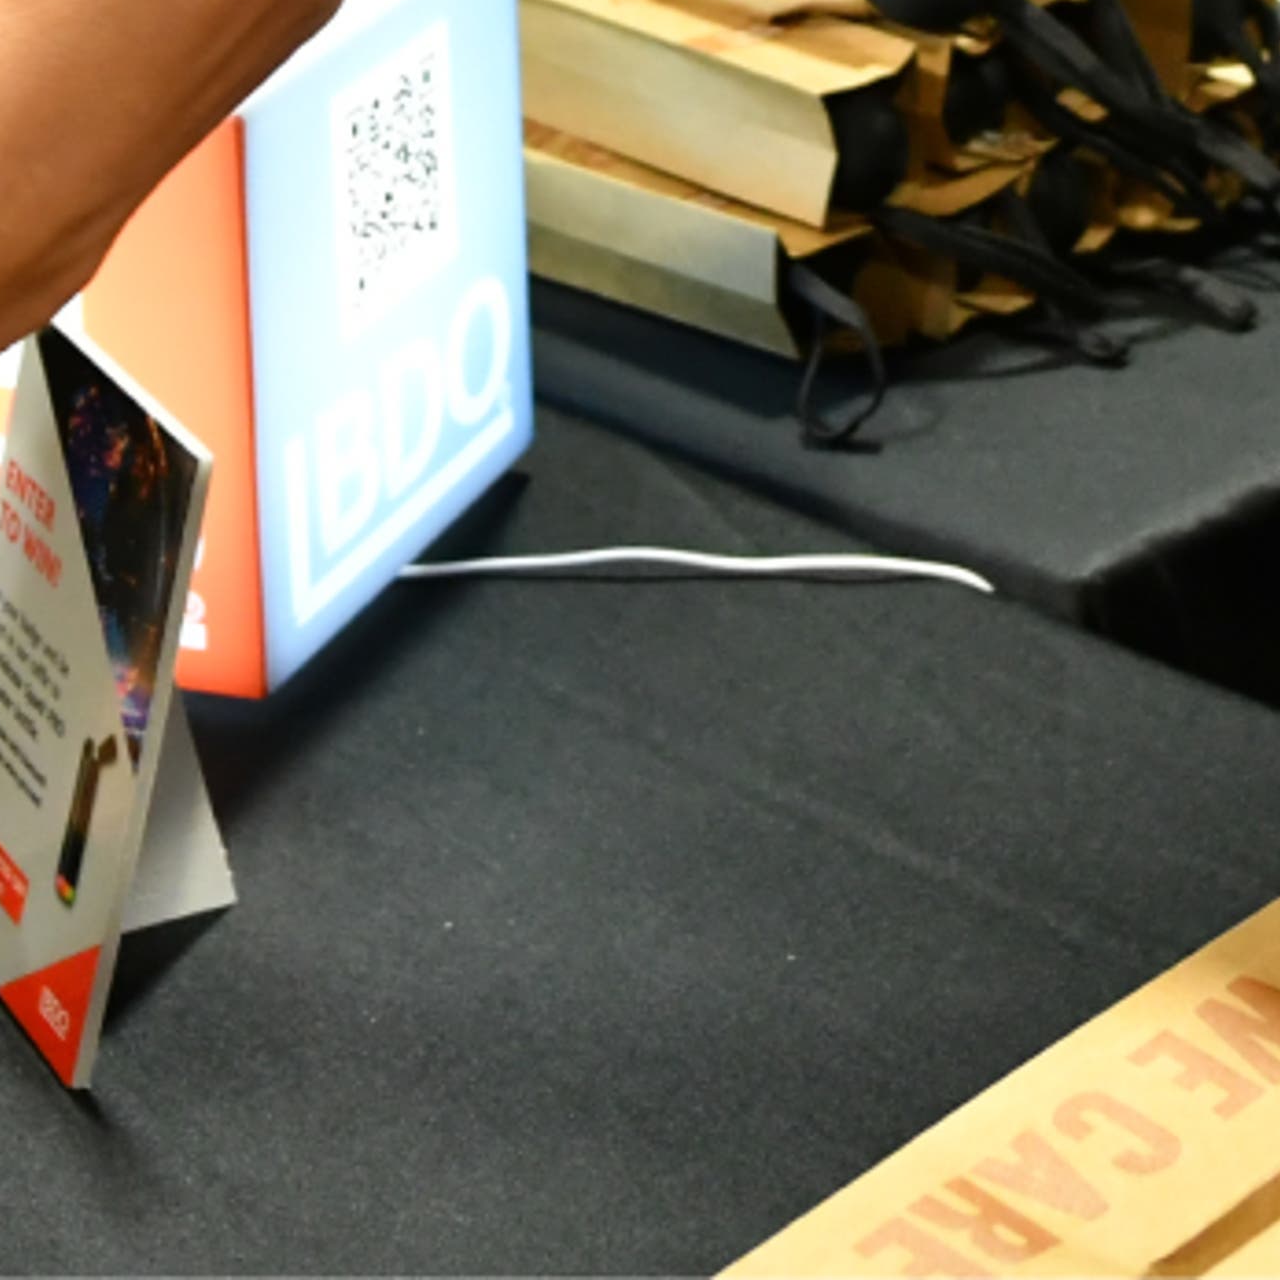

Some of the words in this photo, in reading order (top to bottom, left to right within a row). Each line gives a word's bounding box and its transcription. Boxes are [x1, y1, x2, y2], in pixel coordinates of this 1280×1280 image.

[5, 459, 57, 531] ENTER
[318, 276, 513, 558] BDO
[852, 1090, 1184, 1278] CARE
